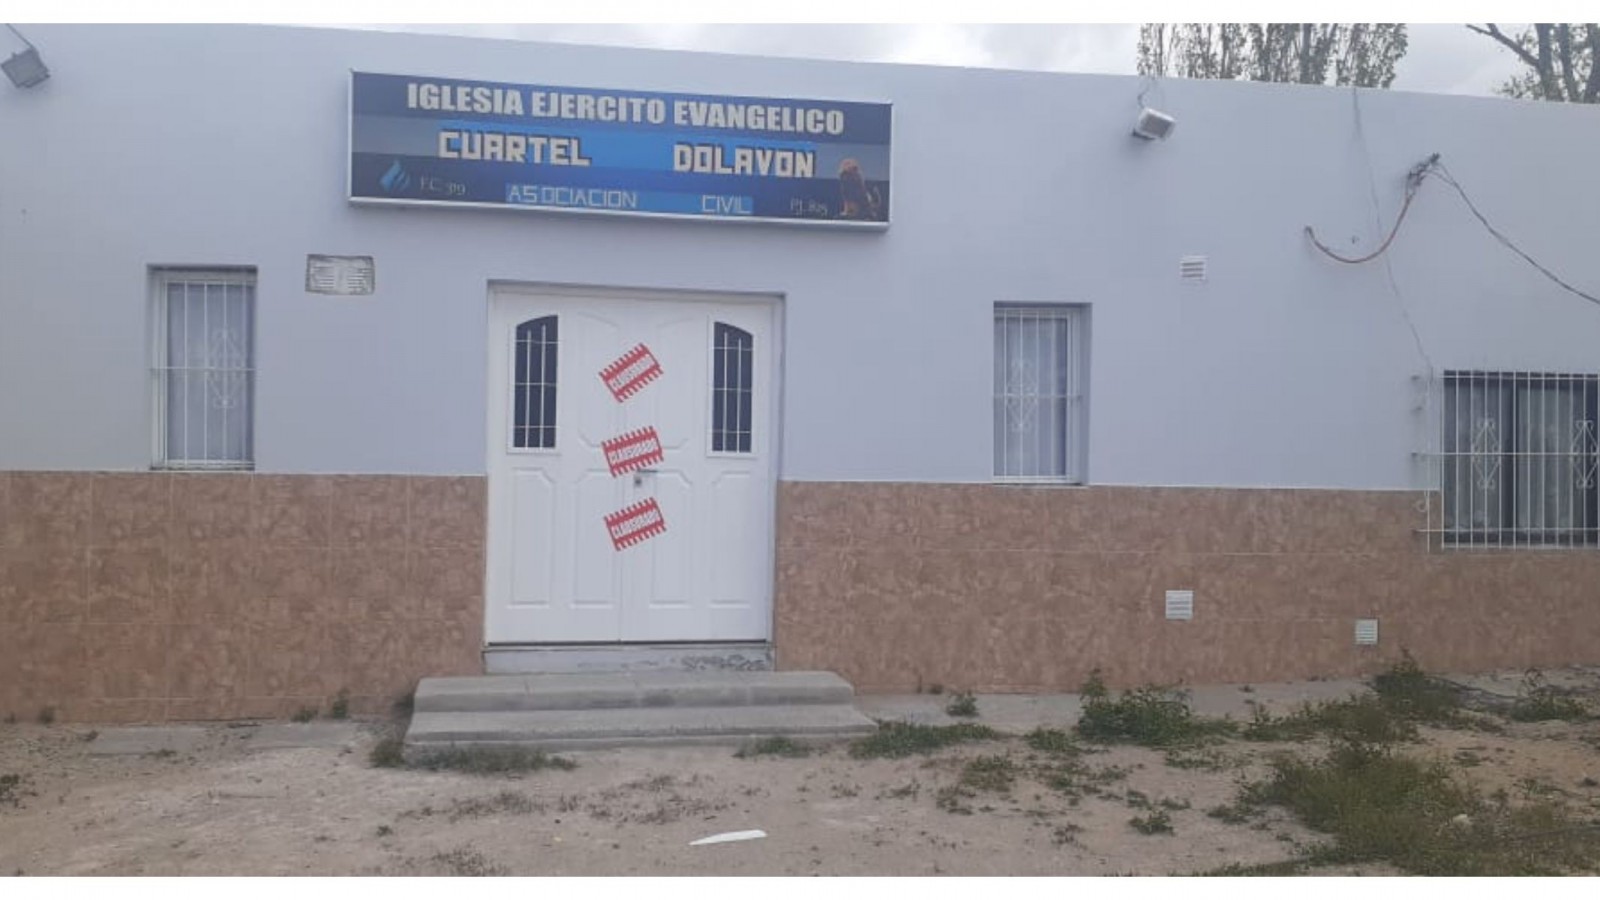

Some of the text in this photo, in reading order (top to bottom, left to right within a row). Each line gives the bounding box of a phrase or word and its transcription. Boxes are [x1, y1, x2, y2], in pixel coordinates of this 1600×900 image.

[407, 83, 844, 135] IGLESIA EJERCITO EVANGELICO
[438, 131, 815, 178] CUARTEL DOLAVON
[702, 194, 750, 214] CIVIL
